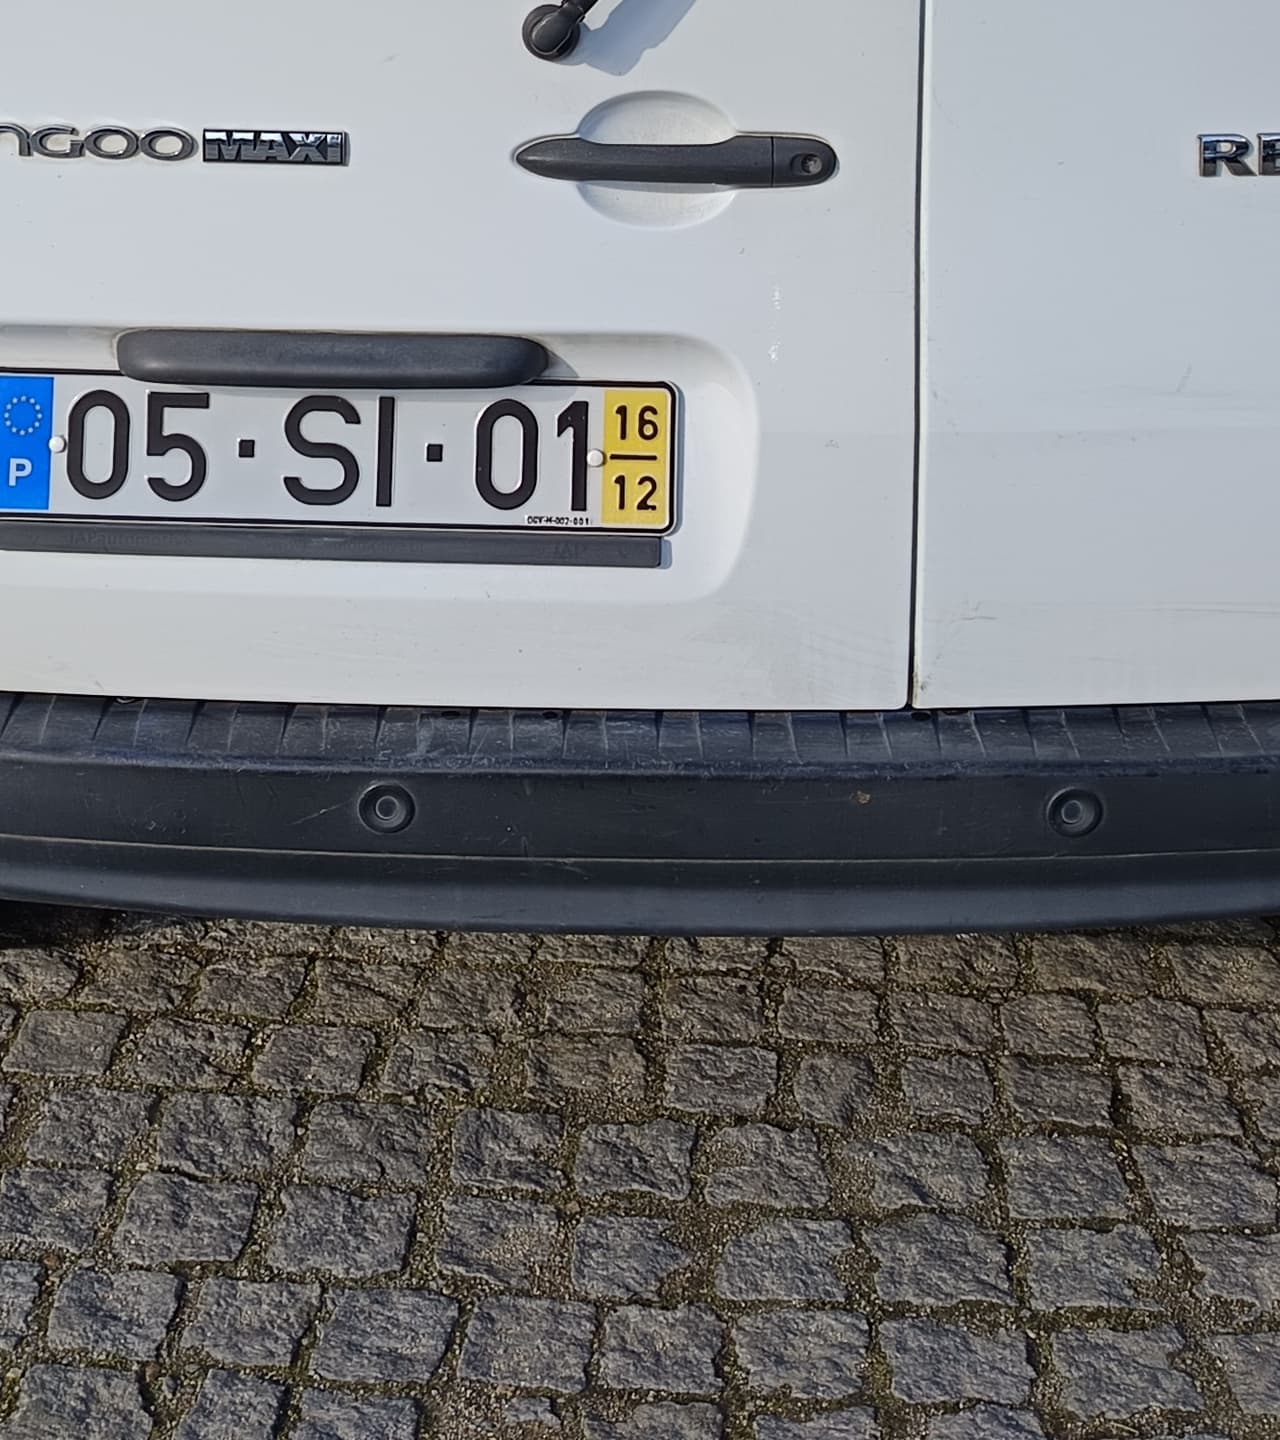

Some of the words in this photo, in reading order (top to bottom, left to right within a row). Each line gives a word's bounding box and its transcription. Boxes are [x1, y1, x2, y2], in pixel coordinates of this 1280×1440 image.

[204, 129, 345, 164] MAXI
[615, 403, 658, 440] 16
[8, 457, 33, 487] P
[612, 474, 658, 512] 12
